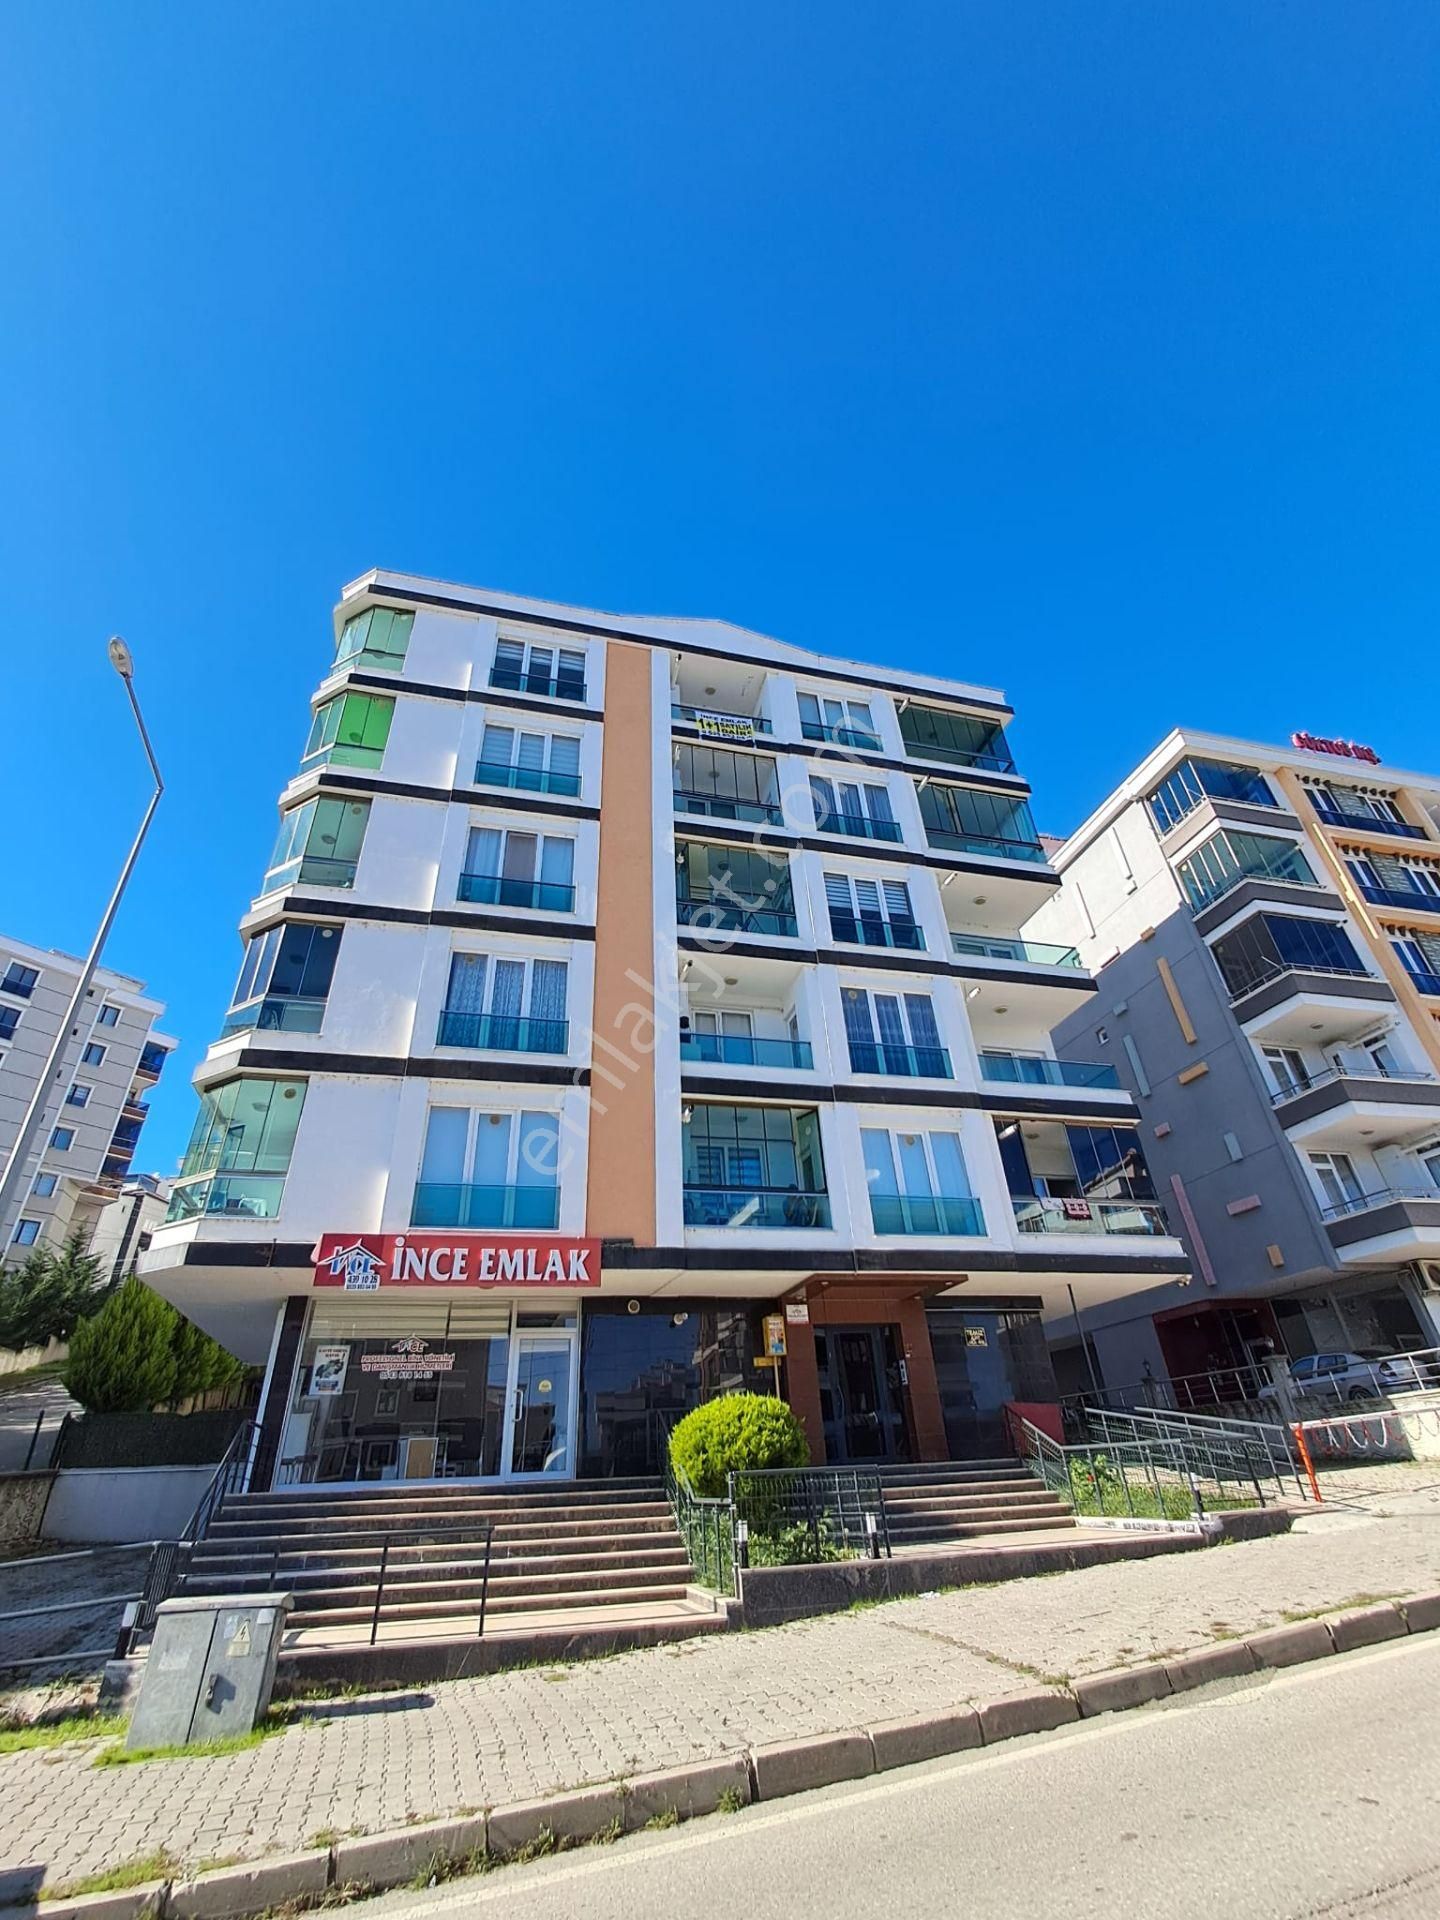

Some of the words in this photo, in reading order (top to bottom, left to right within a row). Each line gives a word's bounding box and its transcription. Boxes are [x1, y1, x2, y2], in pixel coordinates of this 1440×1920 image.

[699, 719, 720, 733] 1+1
[391, 1236, 468, 1281] İNCE
[478, 1248, 591, 1282] EMLAK
